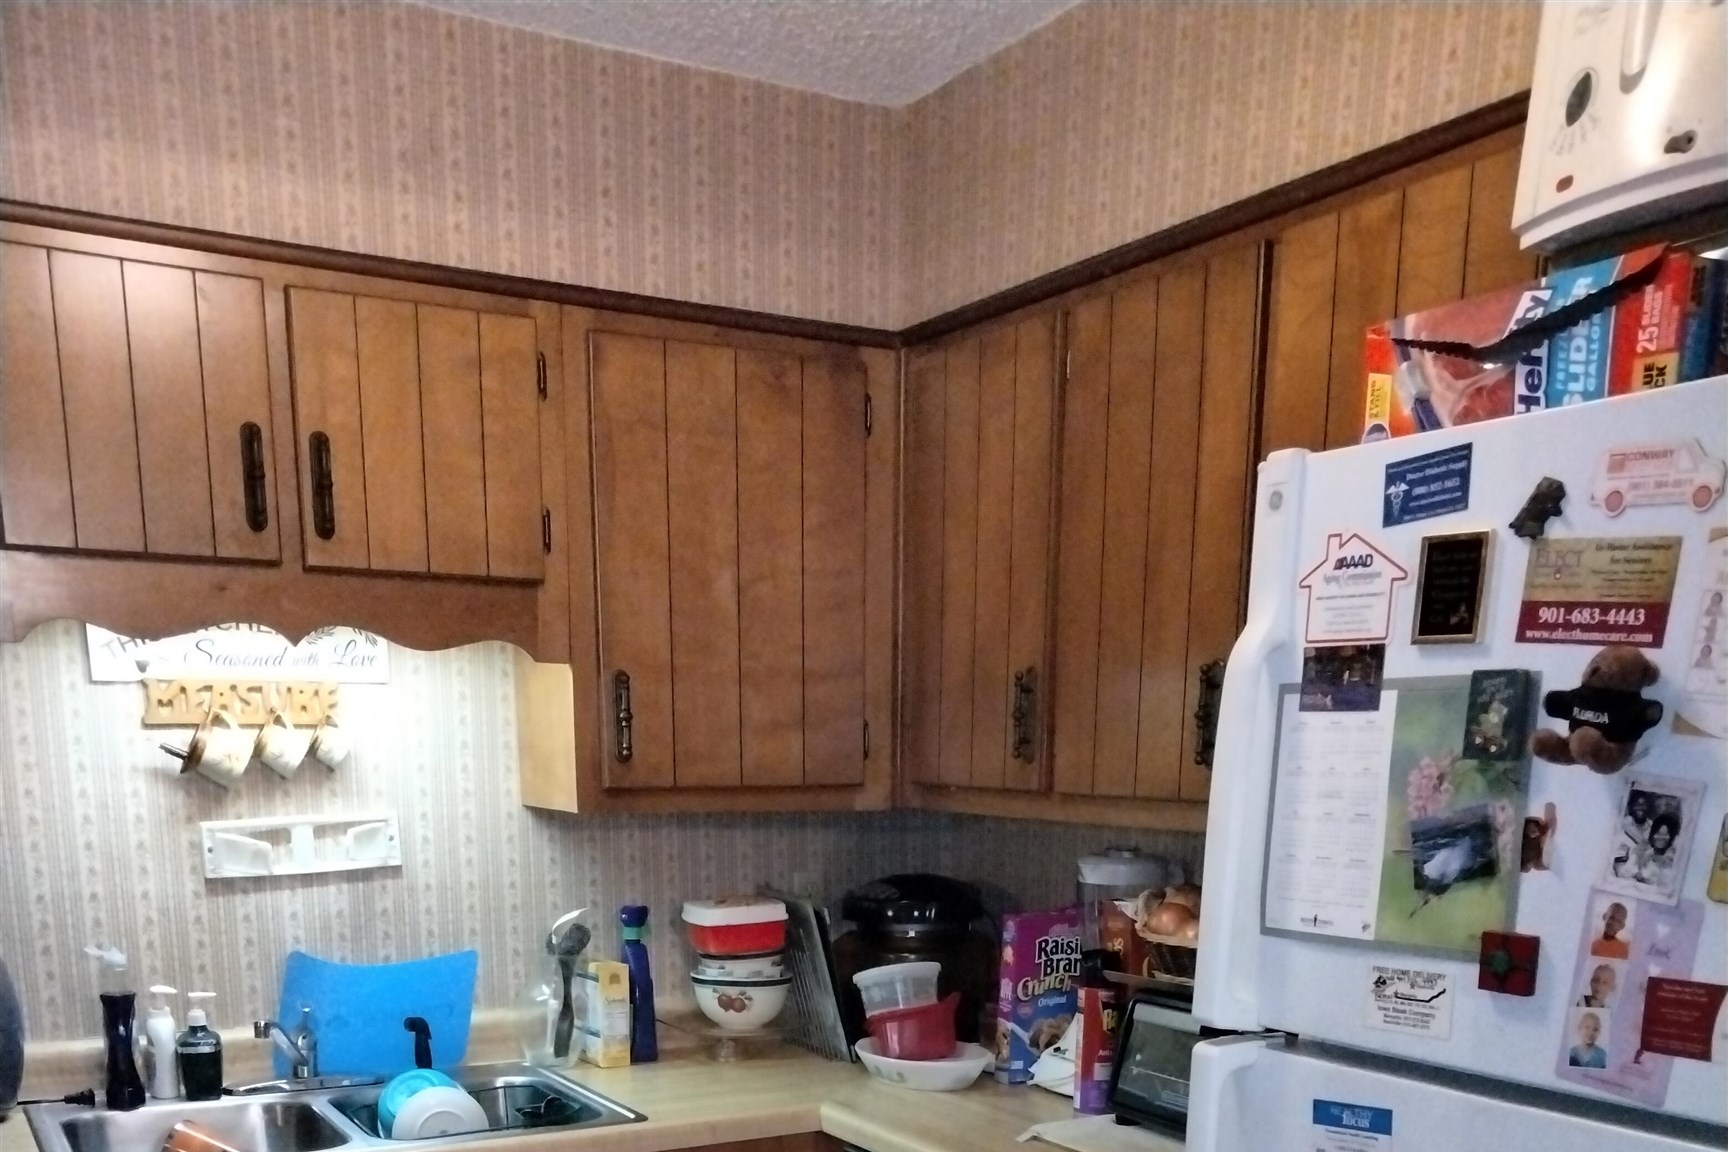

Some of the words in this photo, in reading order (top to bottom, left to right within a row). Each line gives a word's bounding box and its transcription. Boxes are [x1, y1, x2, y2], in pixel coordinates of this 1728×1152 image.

[1636, 326, 1660, 353] 25
[1537, 607, 1646, 626] 901-683-4443
[1525, 628, 1654, 643] www.electhomecare.com
[184, 638, 289, 668] Seasoned
[327, 638, 379, 668] Love
[1036, 936, 1081, 961] Raisi
[1017, 974, 1072, 1001] Crunch
